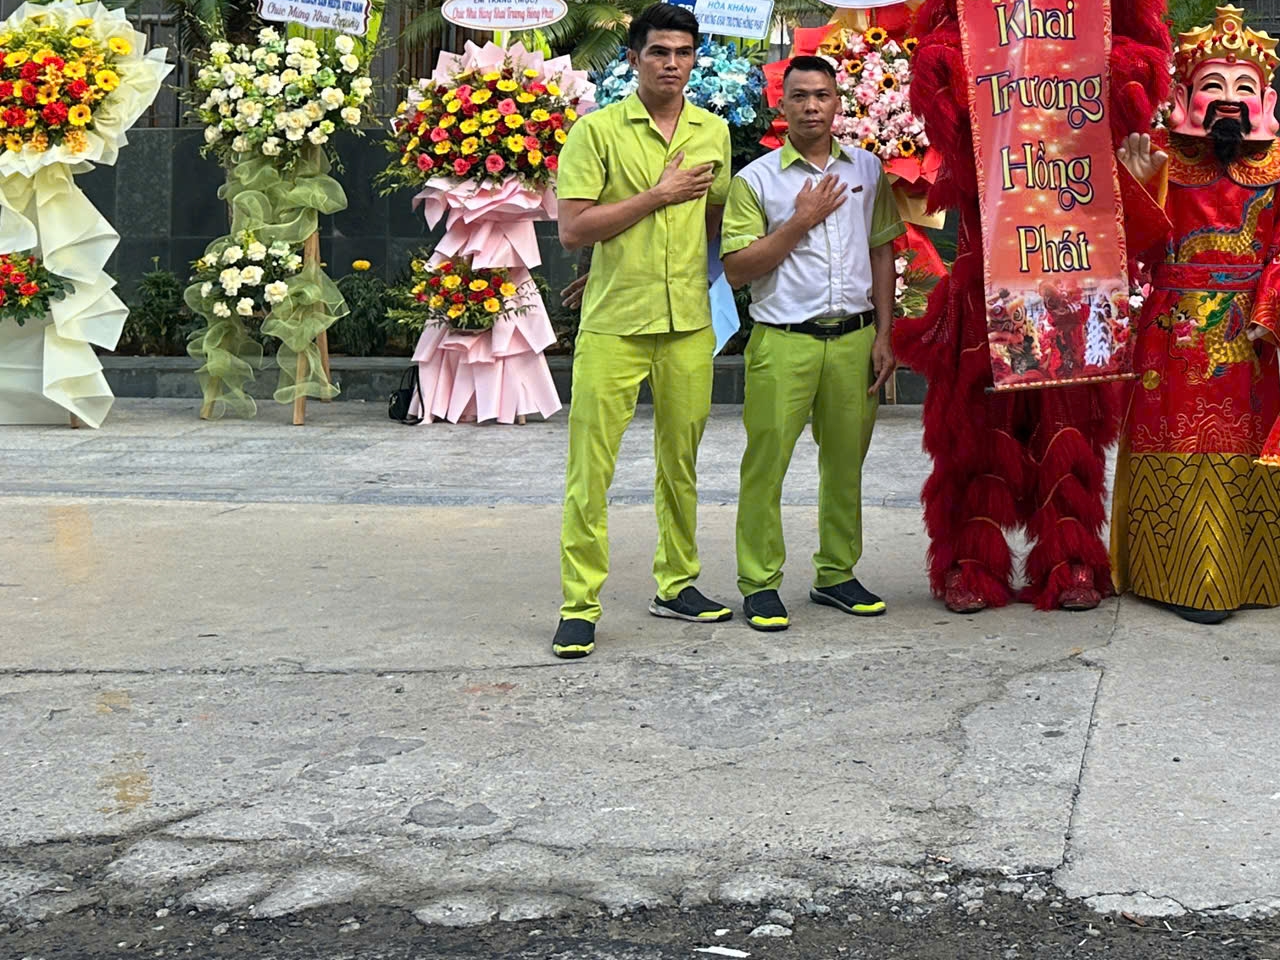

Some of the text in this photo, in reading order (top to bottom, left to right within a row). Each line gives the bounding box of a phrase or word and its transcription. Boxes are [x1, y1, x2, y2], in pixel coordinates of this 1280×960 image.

[707, 0, 725, 10] HÒA
[727, 2, 757, 13] KHÁNH
[976, 70, 1104, 129] Trương
[1000, 141, 1095, 210] Hồng
[1017, 224, 1091, 272] Phát
